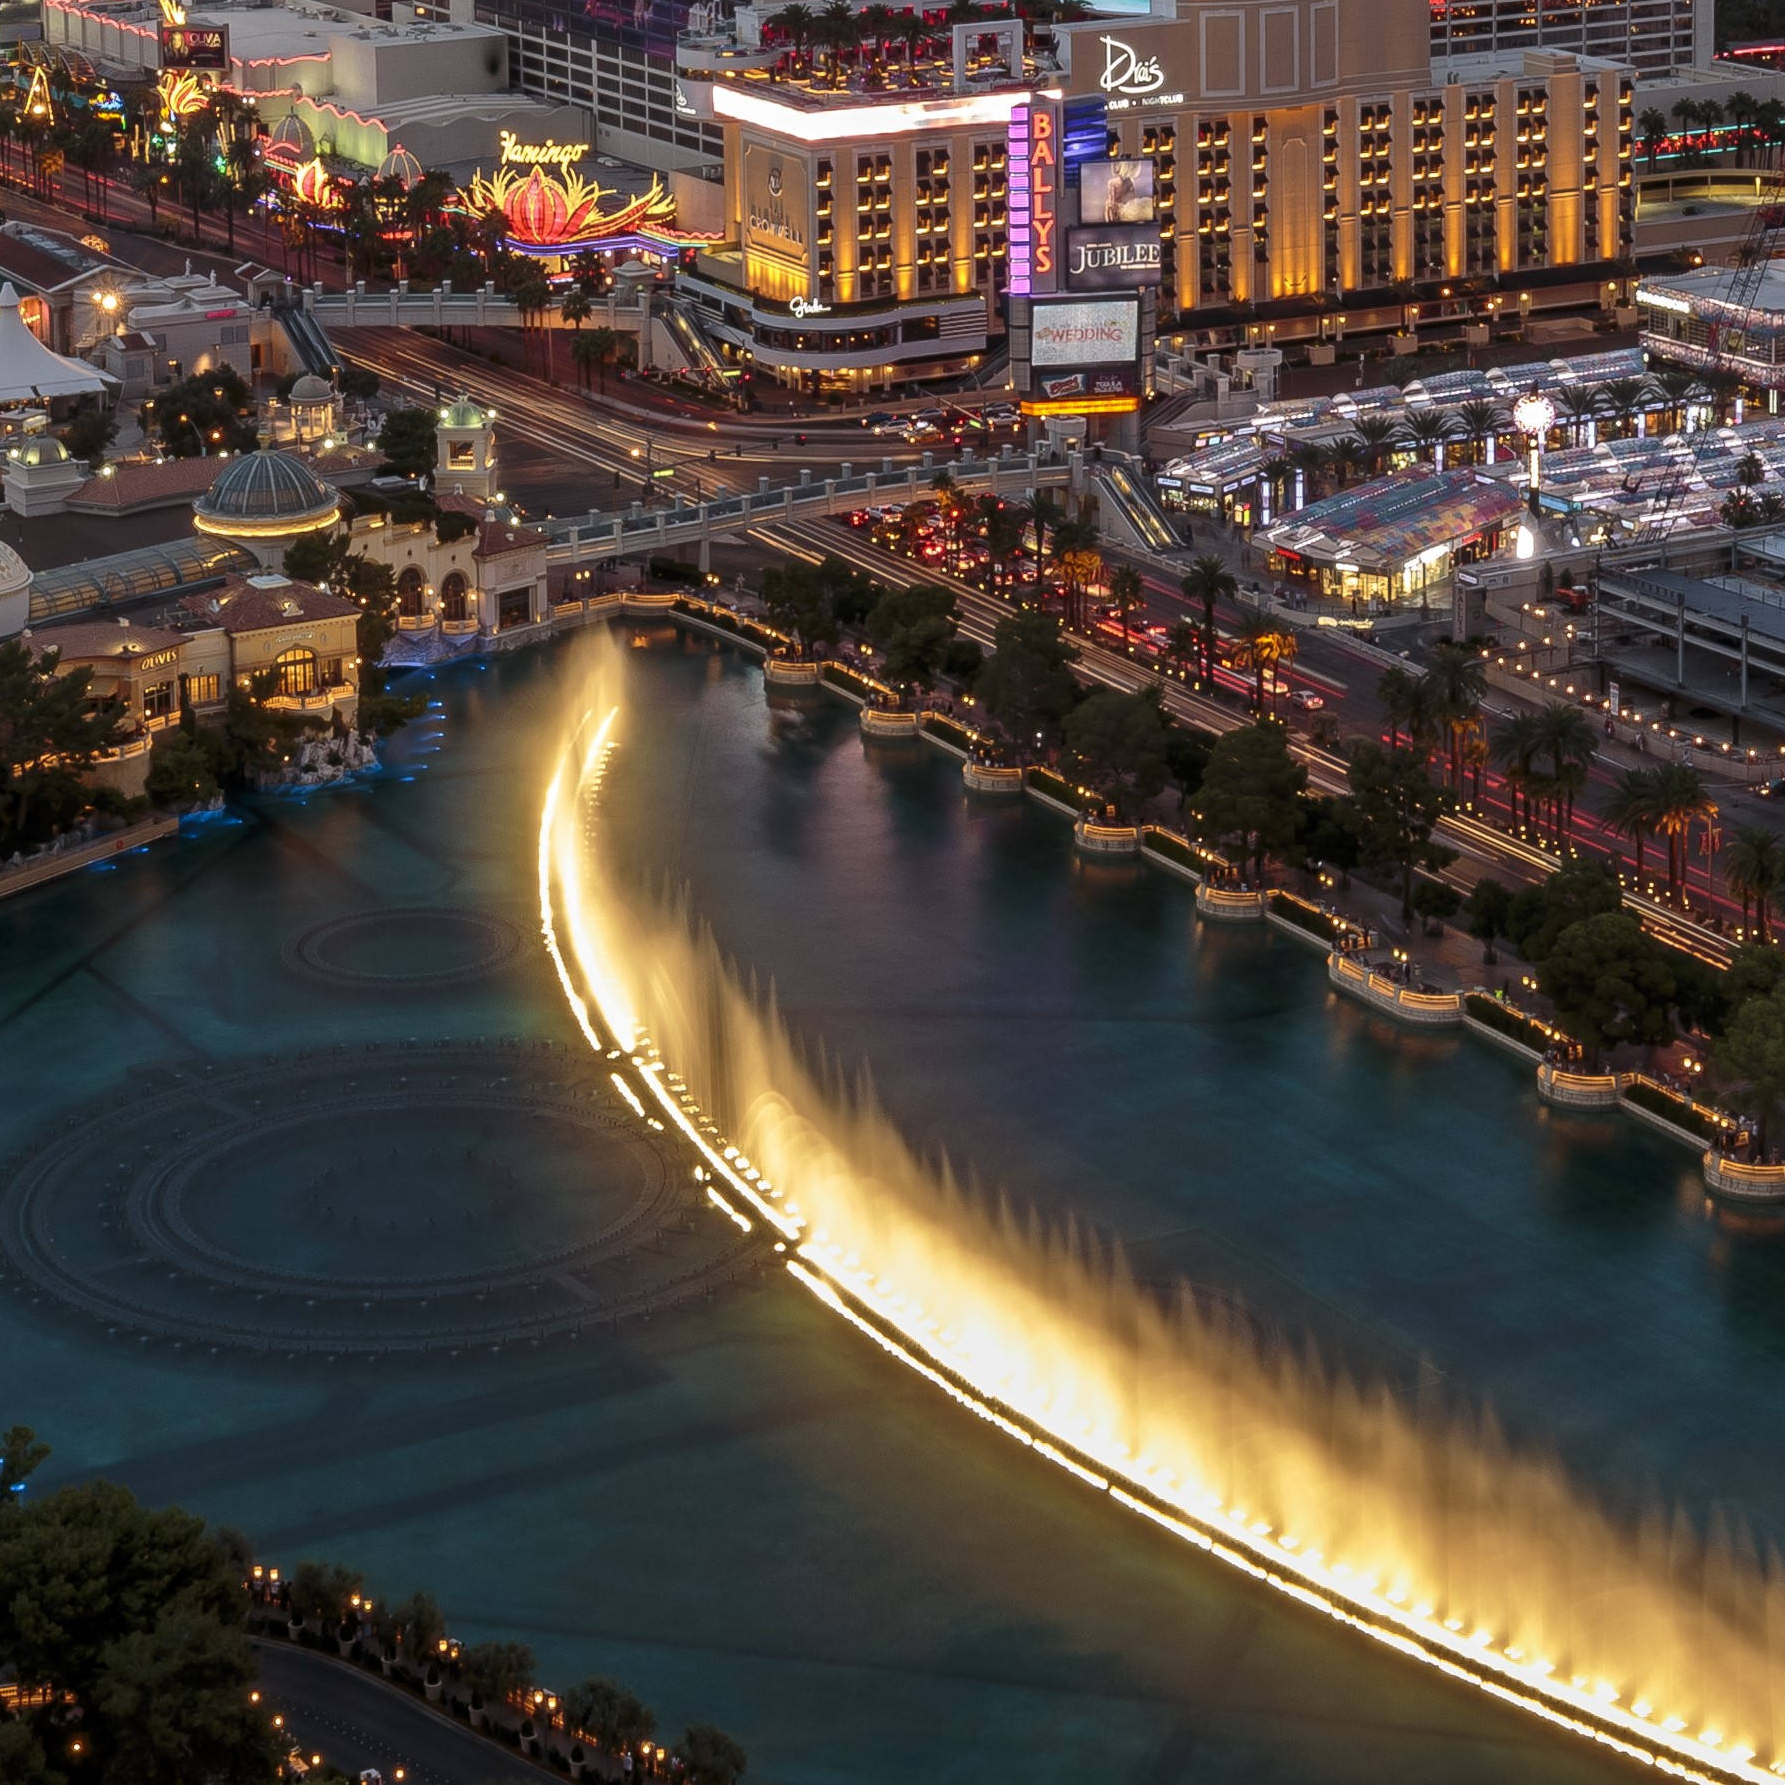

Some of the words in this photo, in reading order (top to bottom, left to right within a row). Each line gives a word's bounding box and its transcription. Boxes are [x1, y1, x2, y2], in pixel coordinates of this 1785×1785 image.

[1099, 35, 1164, 93] Drai's
[1108, 99, 1129, 110] CLUB
[1141, 94, 1184, 105] NIGHTCLUB
[500, 130, 589, 172] Flamingo
[749, 215, 803, 246] CROMWELL
[1070, 243, 1161, 274] JUBILEE
[1051, 327, 1123, 342] WEDDING
[141, 651, 177, 671] OLIVES
